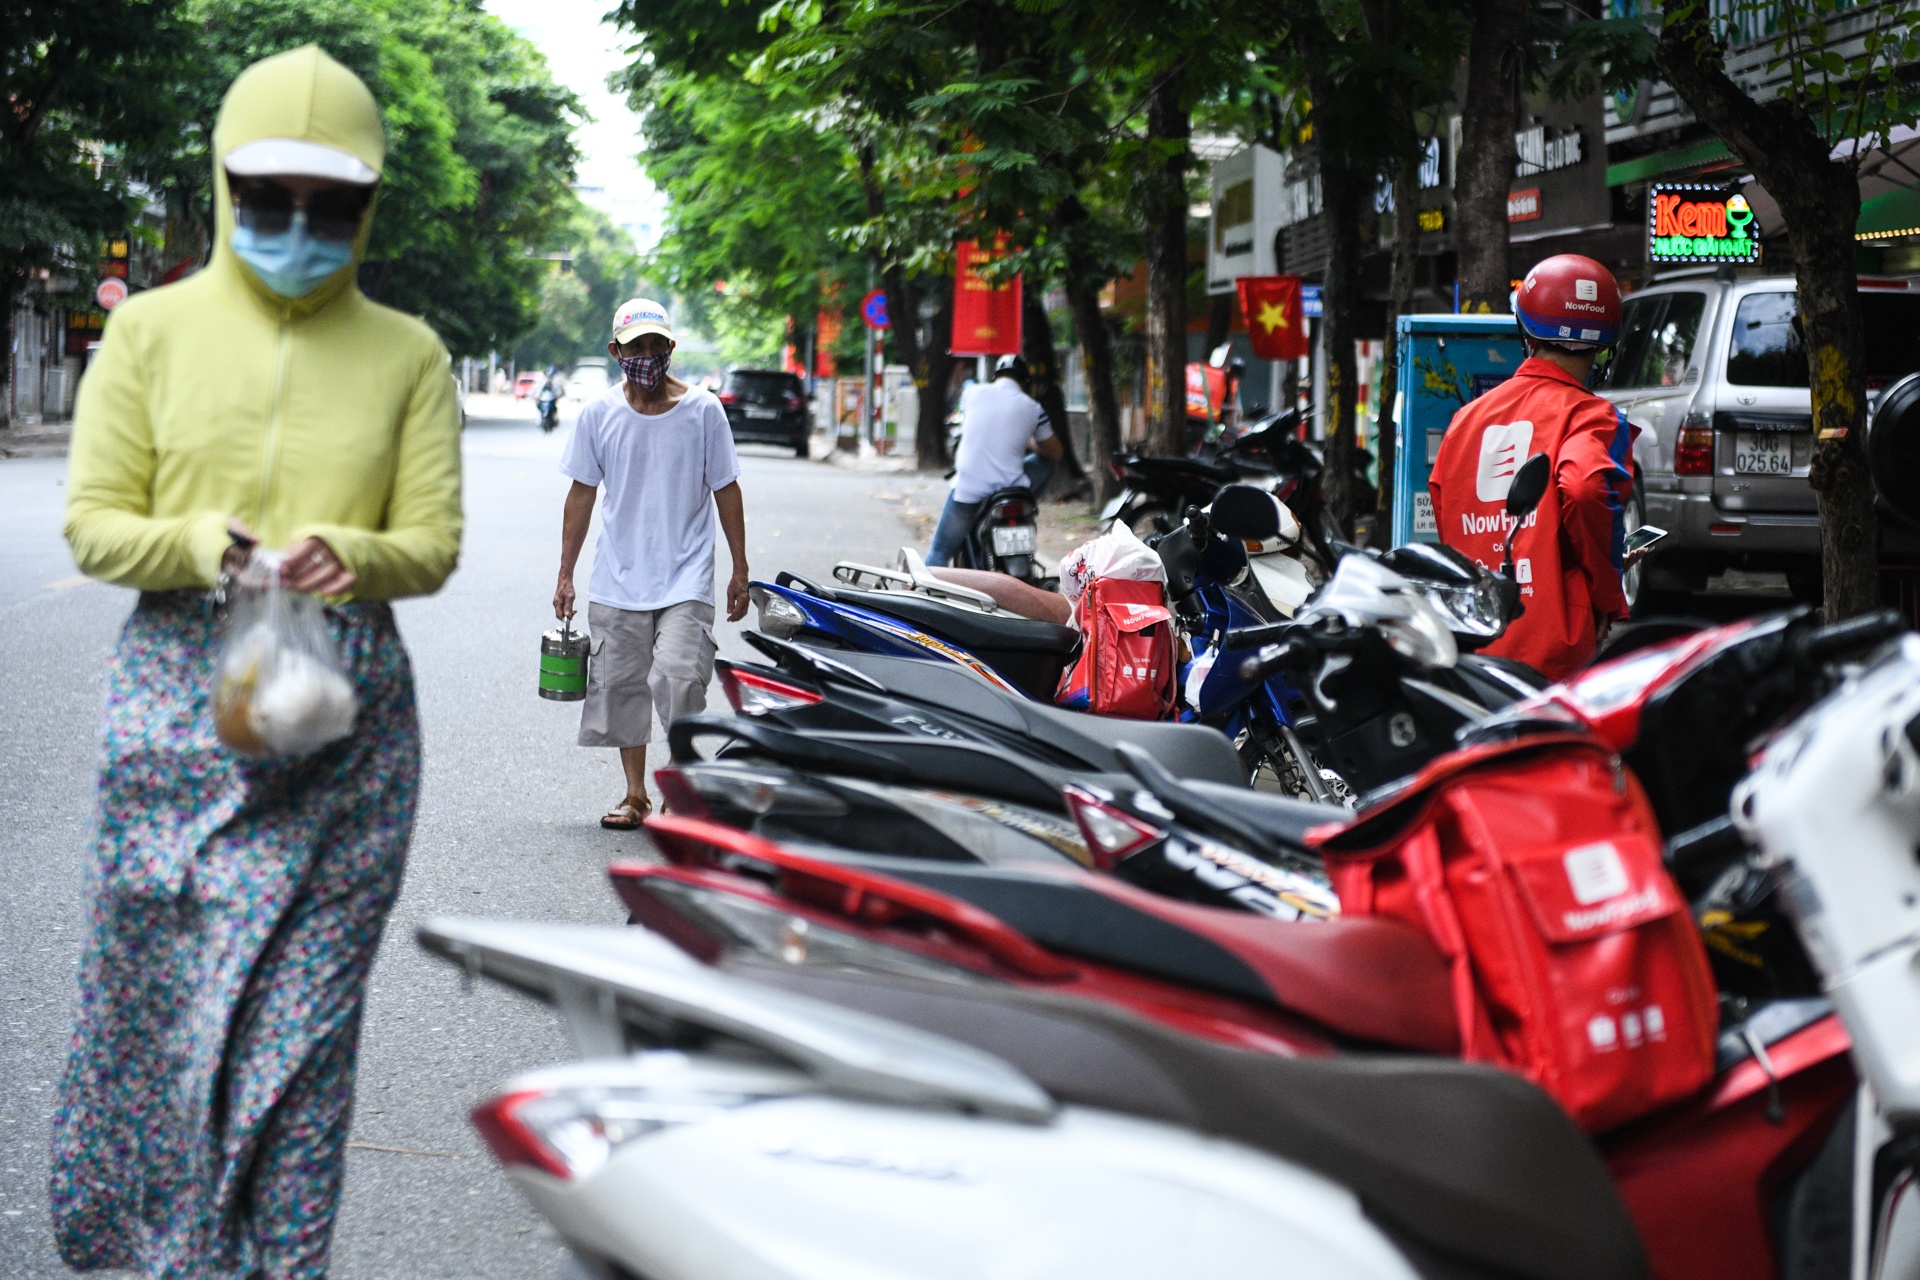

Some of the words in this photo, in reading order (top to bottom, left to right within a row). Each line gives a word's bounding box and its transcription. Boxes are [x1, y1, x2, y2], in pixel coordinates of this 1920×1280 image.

[1656, 194, 1727, 237] Kem
[1565, 301, 1605, 313] NowFood
[1737, 454, 1789, 473] 025.64
